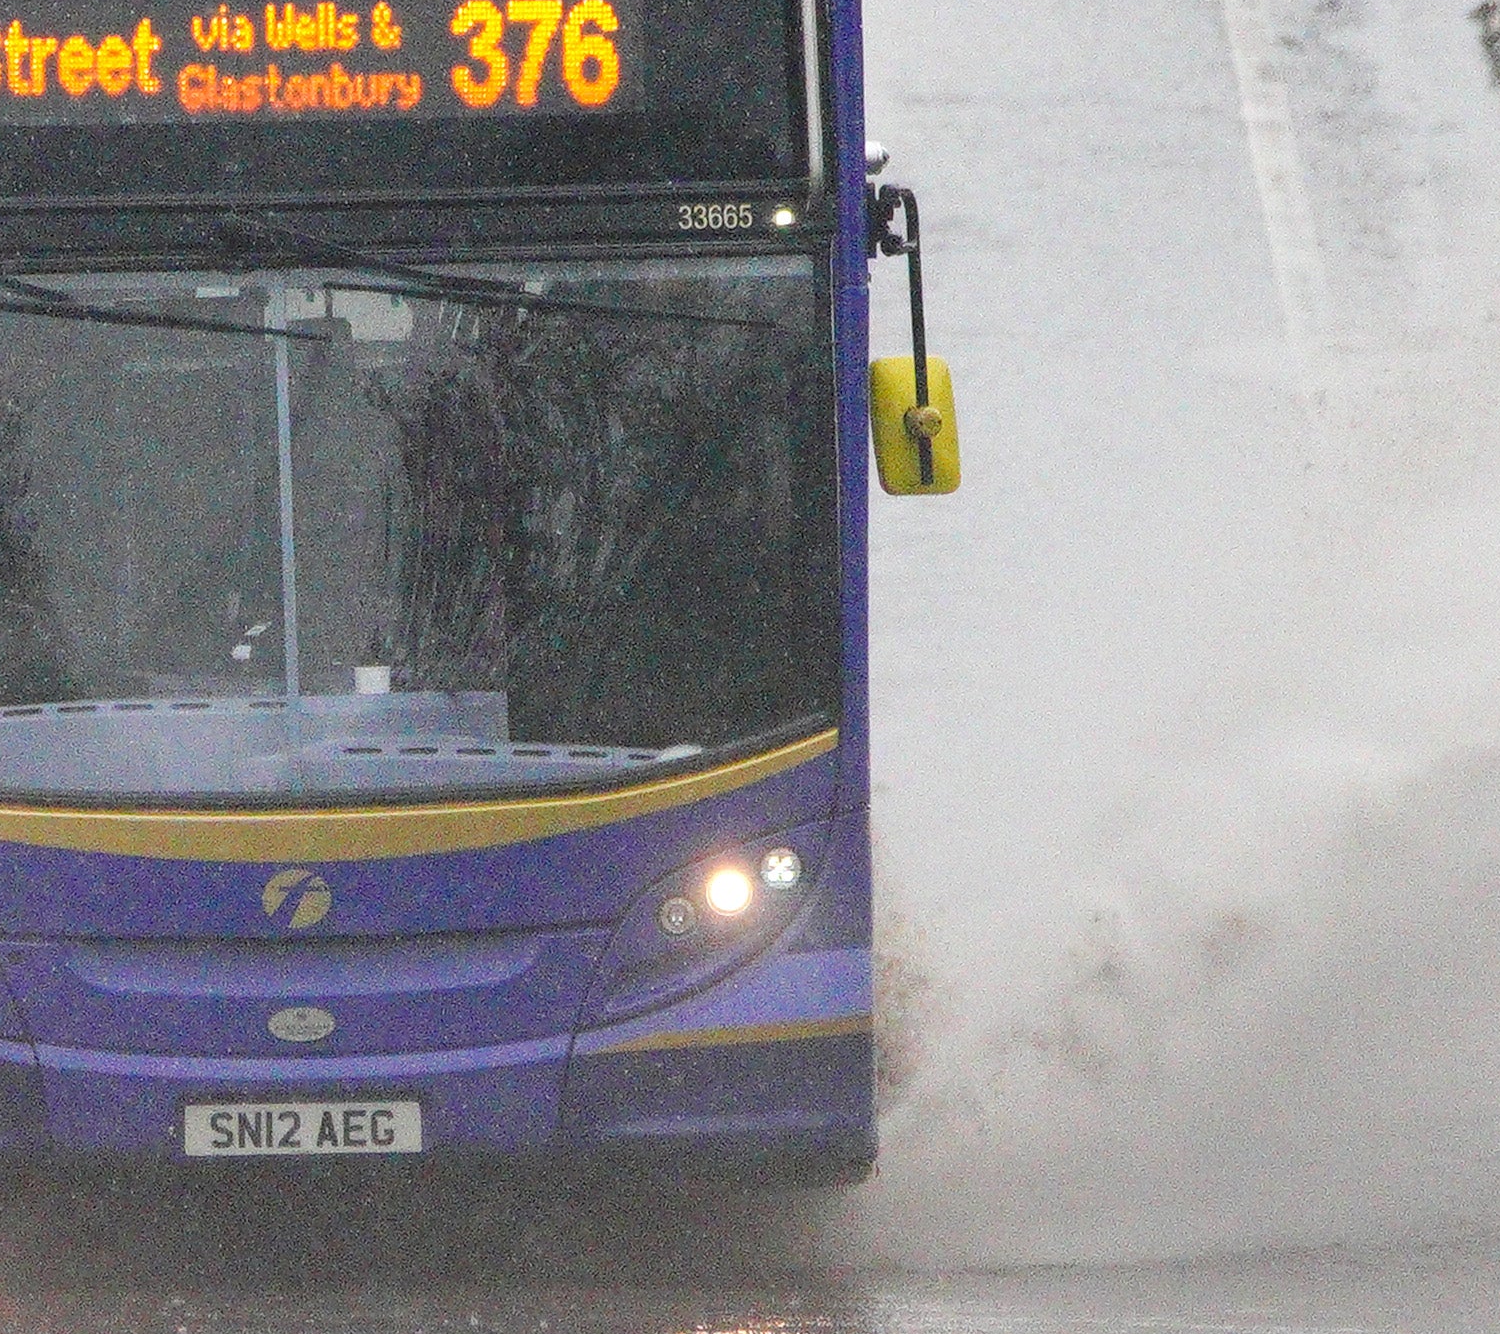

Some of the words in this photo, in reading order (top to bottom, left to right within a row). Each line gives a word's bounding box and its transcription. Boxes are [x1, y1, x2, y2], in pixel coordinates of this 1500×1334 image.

[192, 3, 254, 51] via
[265, 1, 359, 50] Wells
[371, 0, 402, 49] &
[177, 62, 422, 112] Glastonbury
[679, 204, 752, 229] 33665
[209, 1111, 300, 1148] SN12
[317, 1110, 394, 1147] AEG
